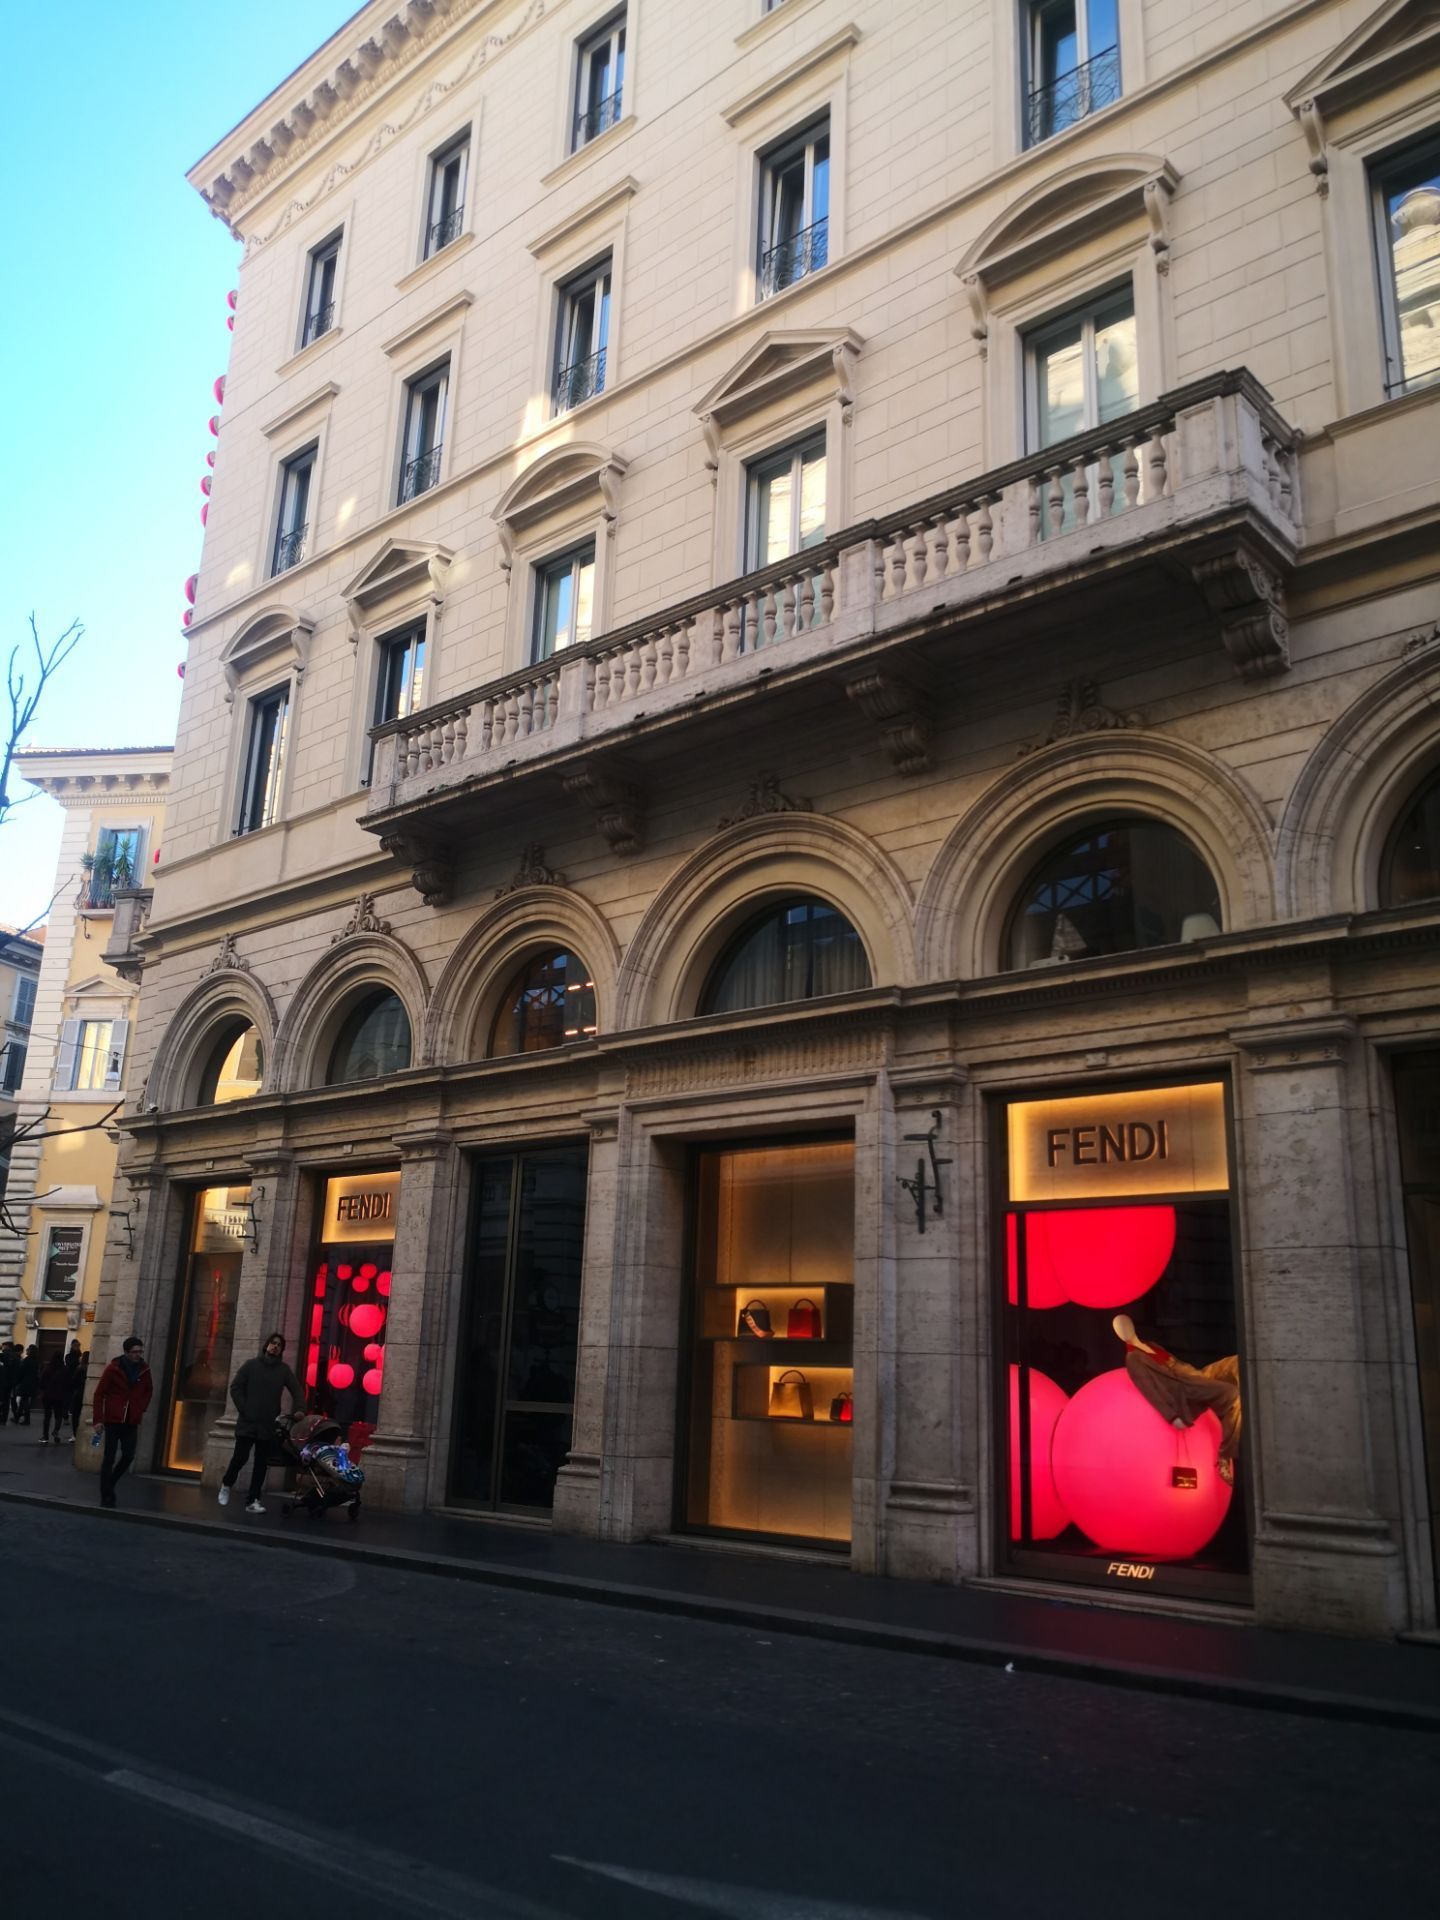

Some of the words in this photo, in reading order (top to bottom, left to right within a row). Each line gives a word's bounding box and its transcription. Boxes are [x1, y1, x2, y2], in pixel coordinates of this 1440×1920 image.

[1047, 1119, 1169, 1167] FENDI
[337, 1191, 391, 1221] FENDI
[1106, 1562, 1155, 1579] FENDI
